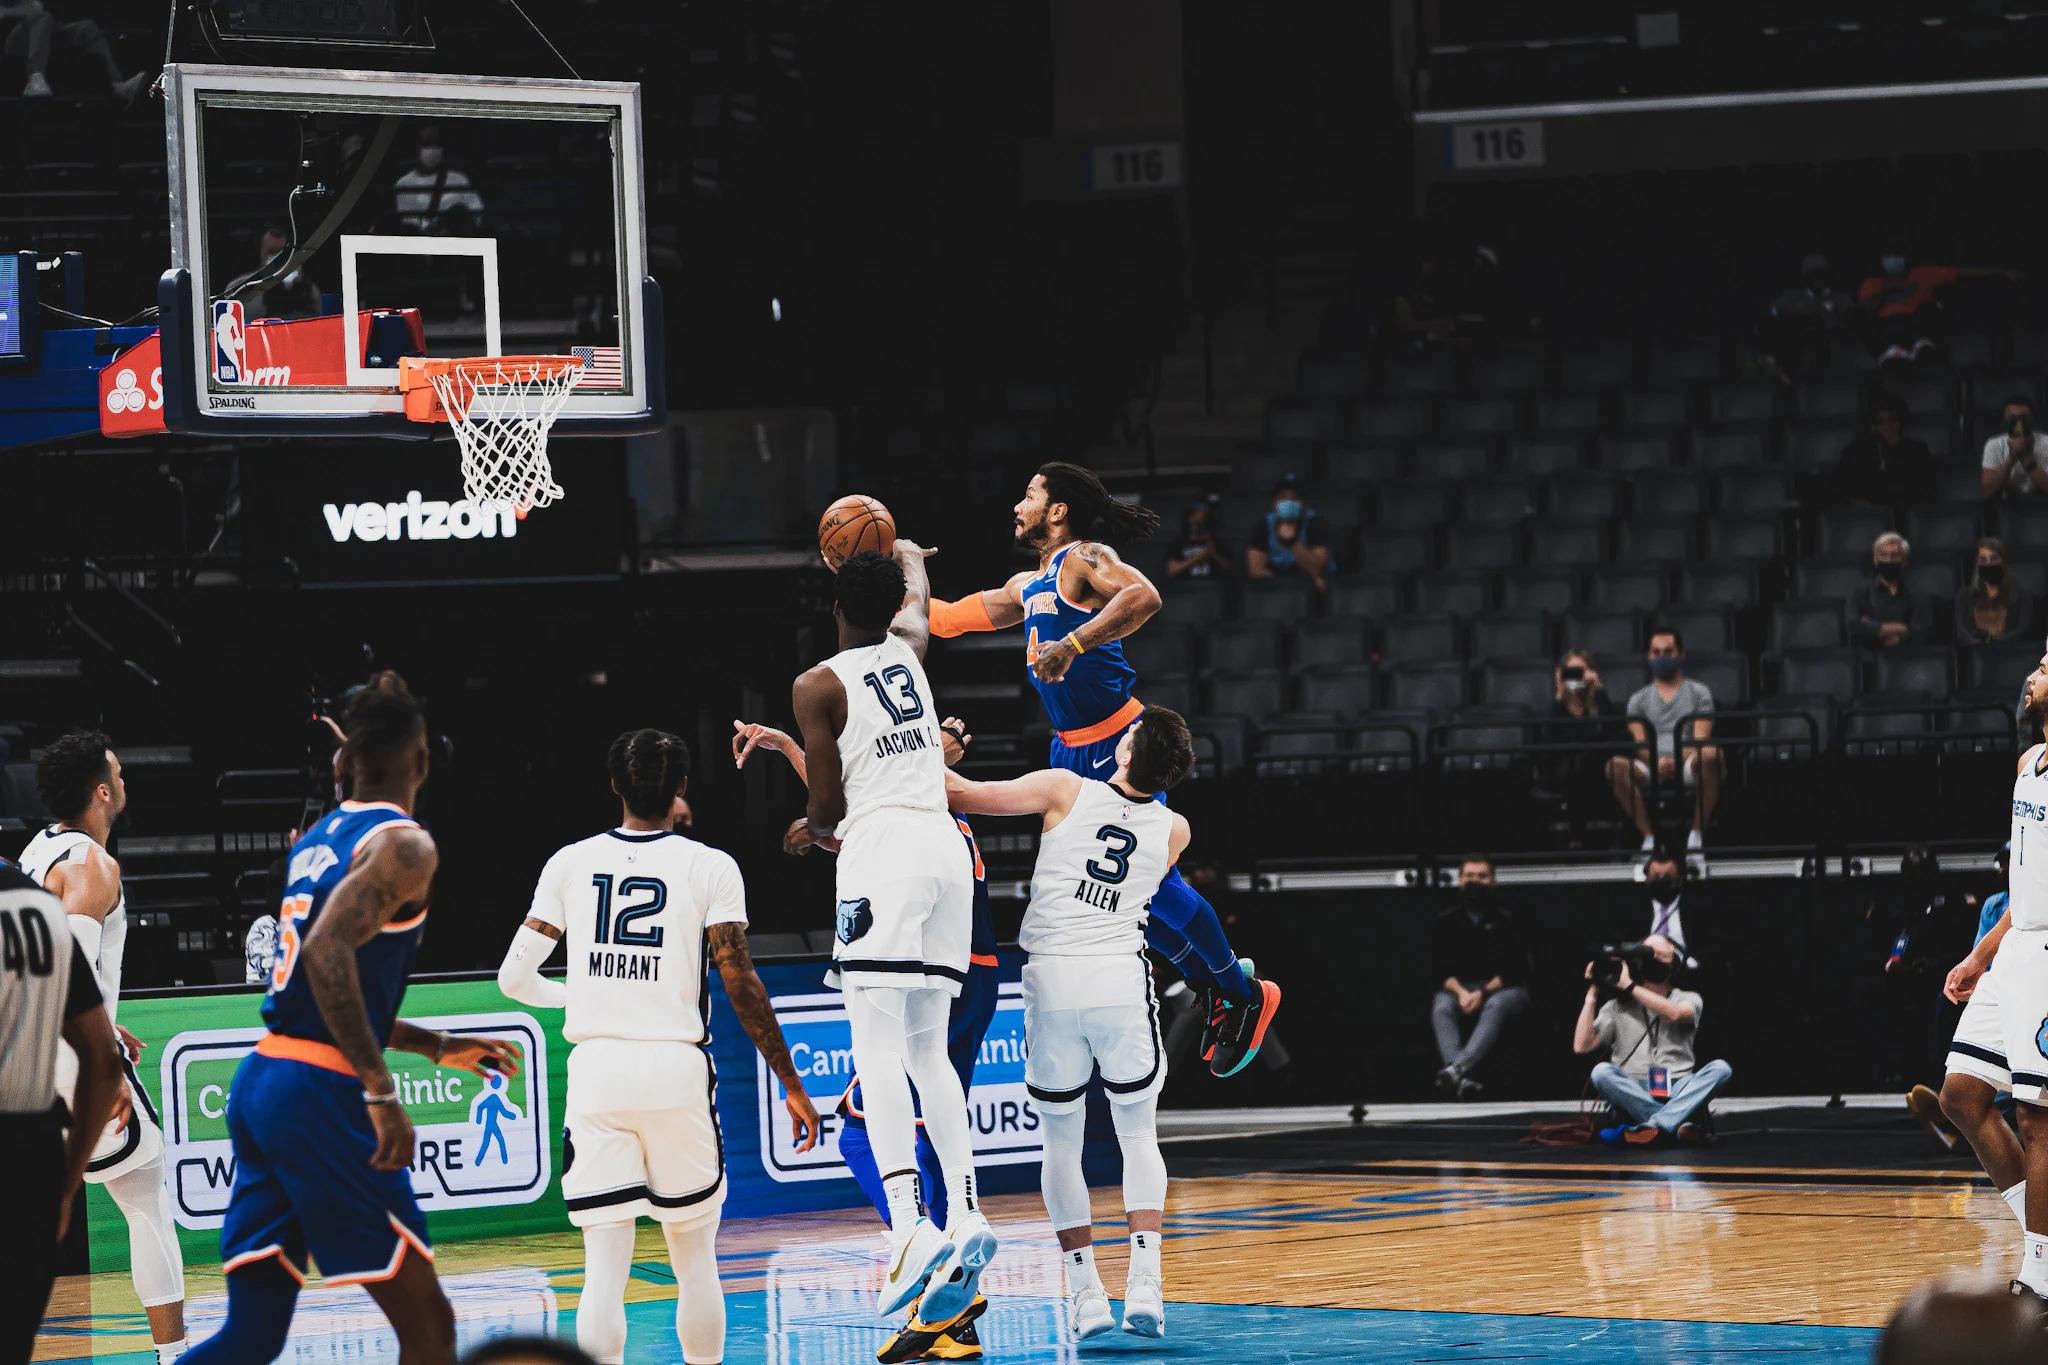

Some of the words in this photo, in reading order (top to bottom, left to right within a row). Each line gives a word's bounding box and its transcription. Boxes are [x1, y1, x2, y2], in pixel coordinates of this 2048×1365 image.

[1472, 127, 1526, 161] 116
[1110, 150, 1164, 183] 116
[220, 366, 236, 380] NBA
[208, 396, 256, 410] SPALDING
[323, 490, 517, 542] verizon
[863, 663, 924, 726] 13
[1086, 824, 1138, 885] 3
[592, 873, 667, 948] 12
[1074, 879, 1121, 913] ALLEN
[0, 906, 55, 980] 40
[588, 951, 661, 982] MORANT
[391, 1069, 463, 1105] linic
[966, 1100, 1039, 1135] URS
